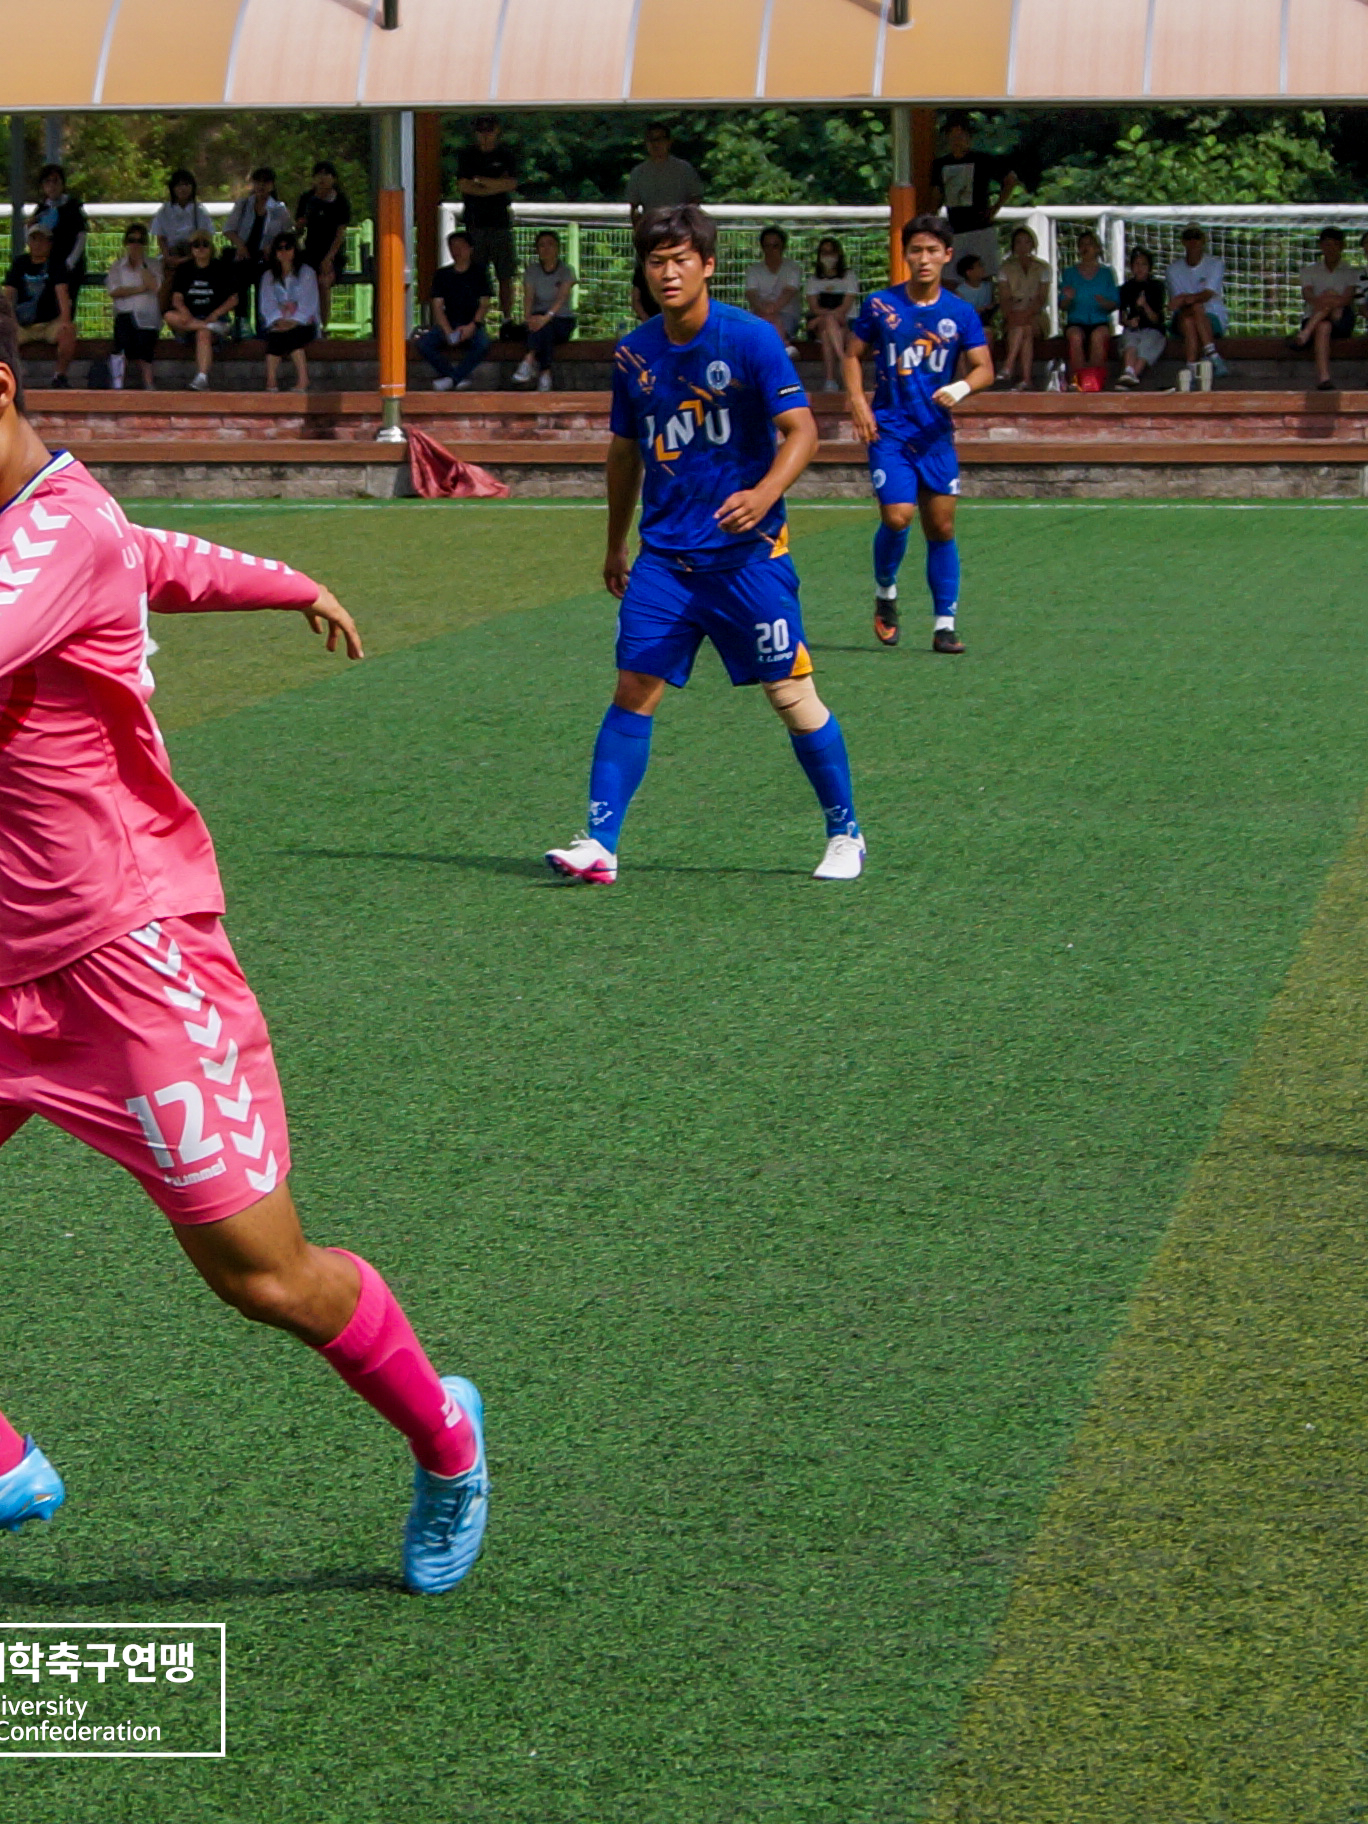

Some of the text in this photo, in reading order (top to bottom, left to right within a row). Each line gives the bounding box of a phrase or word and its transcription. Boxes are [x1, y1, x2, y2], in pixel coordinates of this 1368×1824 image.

[887, 342, 950, 373] INU
[645, 408, 731, 450] INU
[755, 618, 790, 654] 20
[126, 1080, 224, 1167] 12
